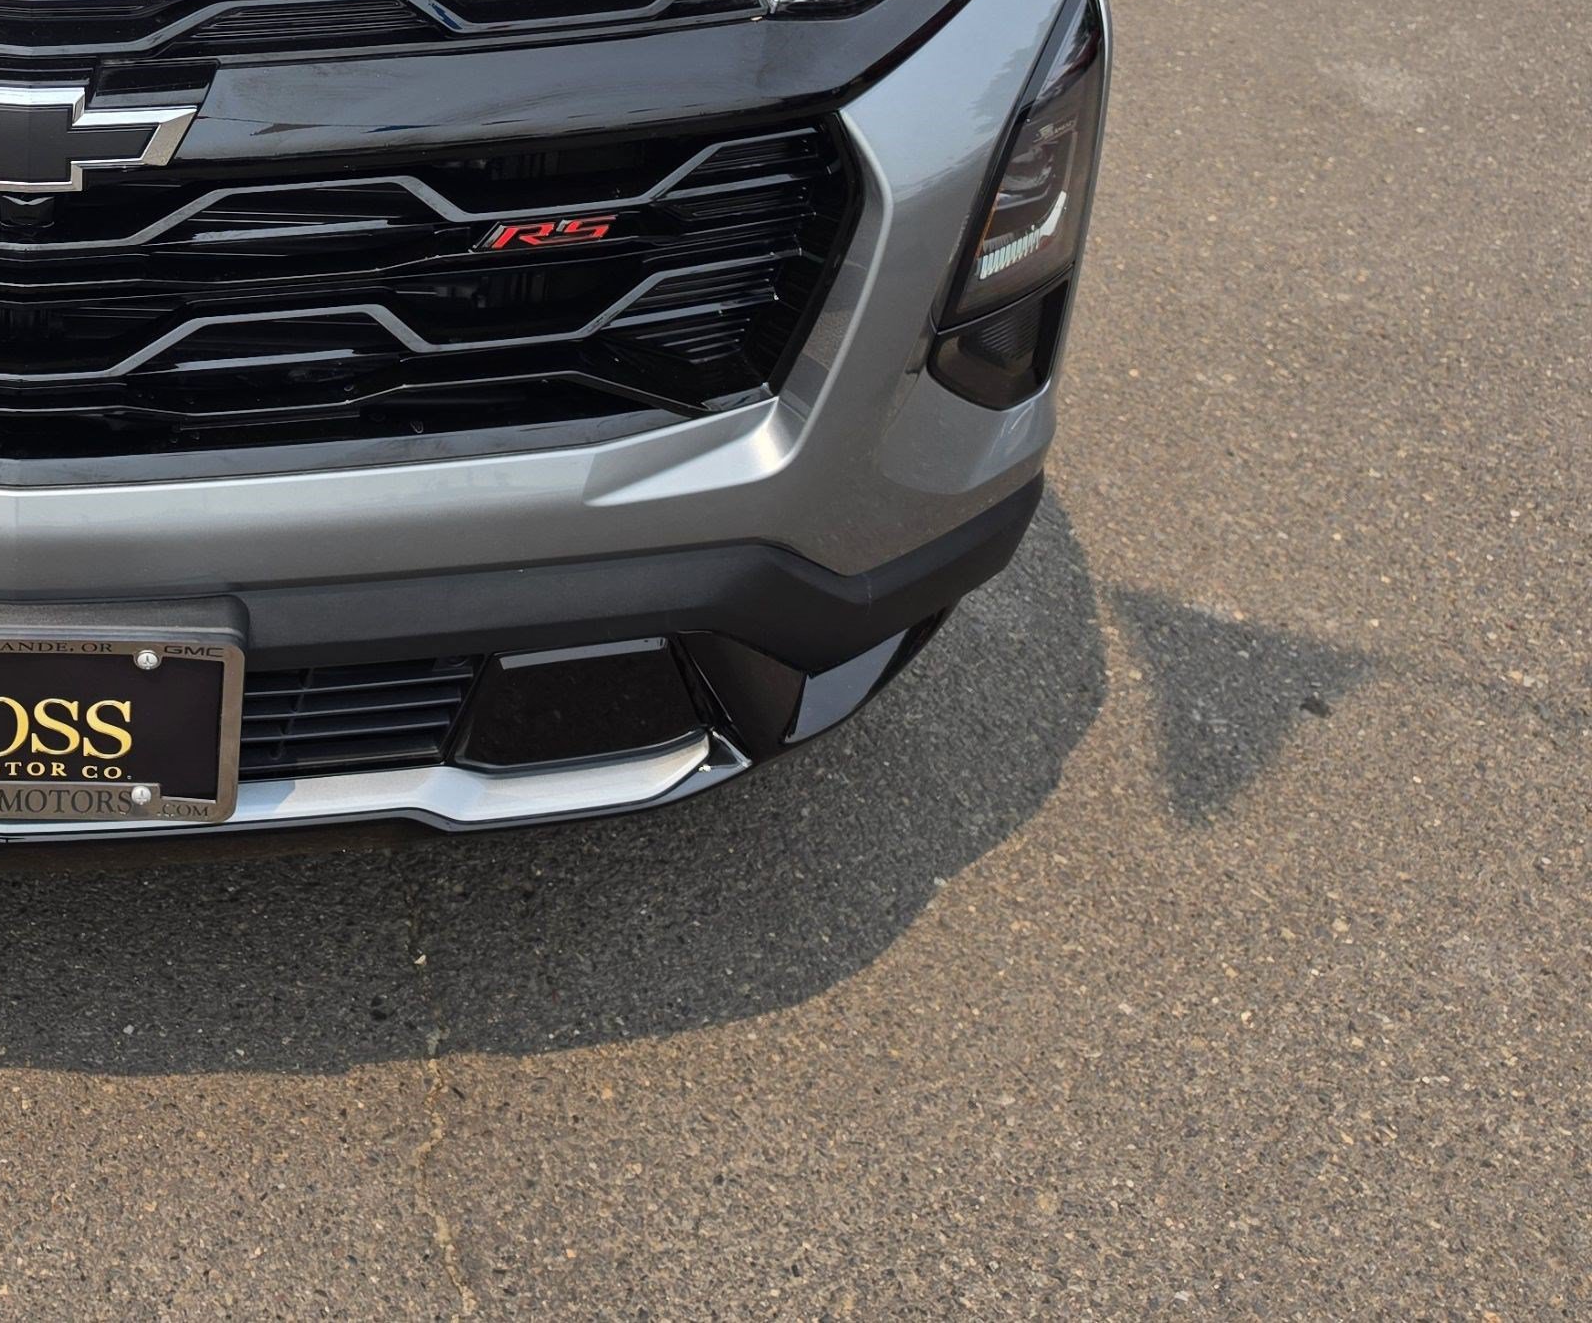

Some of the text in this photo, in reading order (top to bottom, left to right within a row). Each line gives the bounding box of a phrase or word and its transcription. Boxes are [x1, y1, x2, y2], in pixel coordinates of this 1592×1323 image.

[482, 215, 617, 250] RS
[80, 642, 113, 653] OR
[164, 645, 224, 658] GMC
